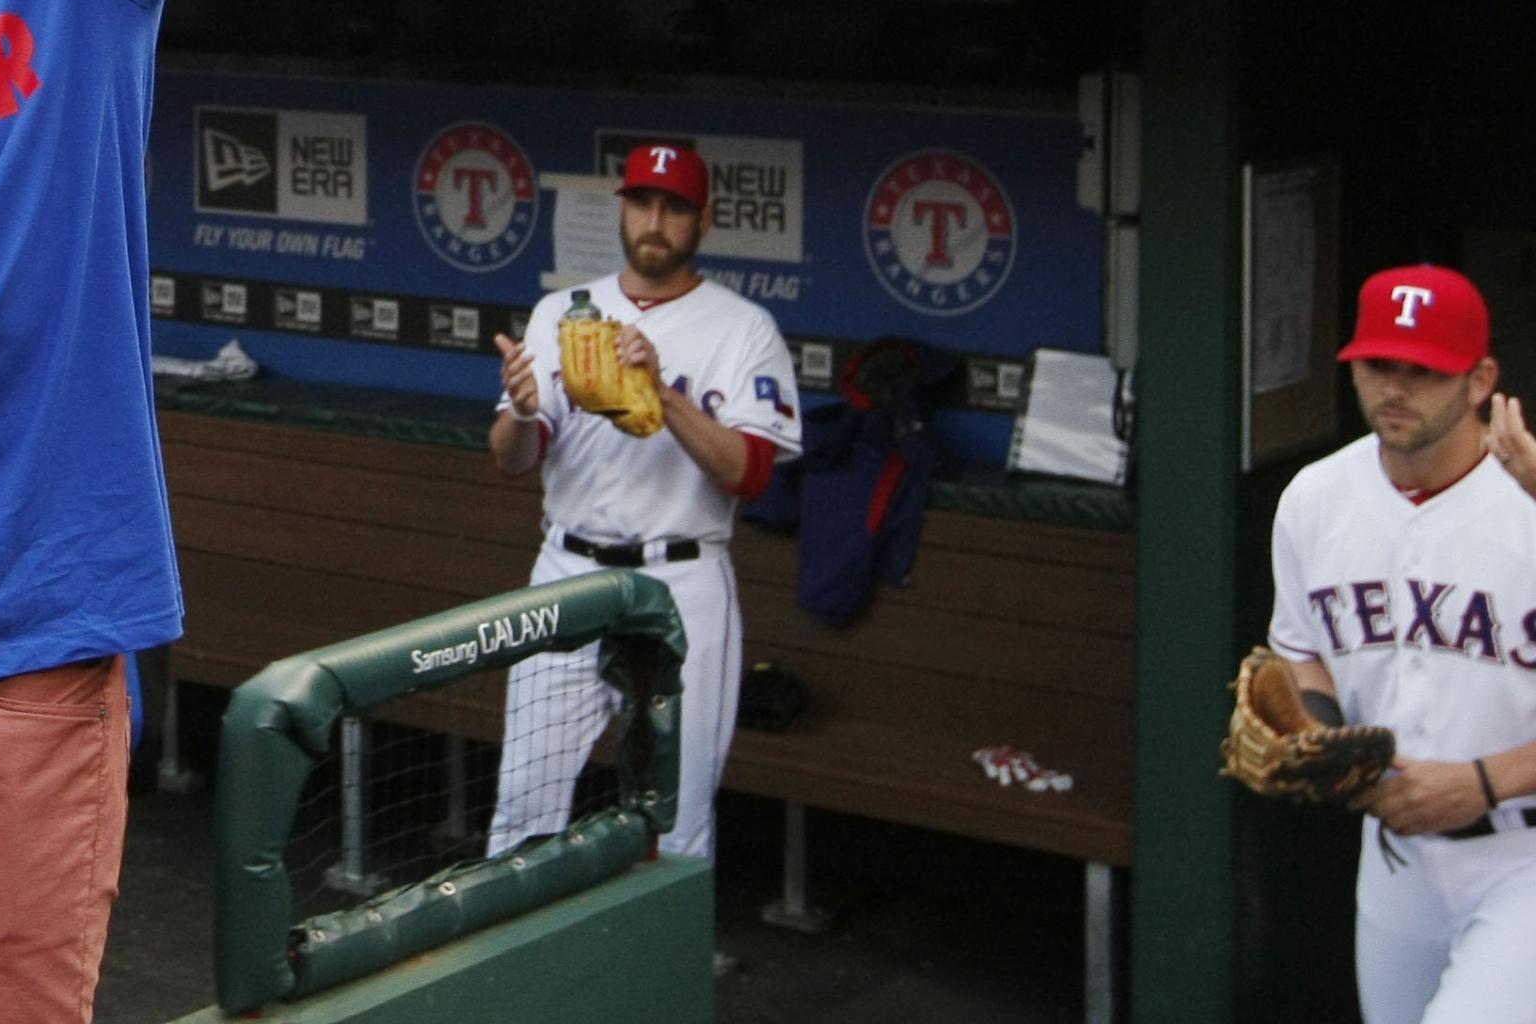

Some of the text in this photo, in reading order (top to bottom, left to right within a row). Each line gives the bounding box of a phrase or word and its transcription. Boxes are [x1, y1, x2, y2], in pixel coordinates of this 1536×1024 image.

[291, 136, 353, 167] NEW
[649, 146, 677, 174] T
[291, 167, 353, 200] ERA
[453, 167, 499, 229] T
[713, 163, 786, 199] NEW
[713, 198, 786, 234] ERA
[913, 199, 968, 268] T
[194, 224, 365, 260] FLY YOUR OWN FLAG
[748, 275, 801, 301] FLAG
[1391, 285, 1434, 328] T
[411, 603, 560, 674] Samsung GALAXY
